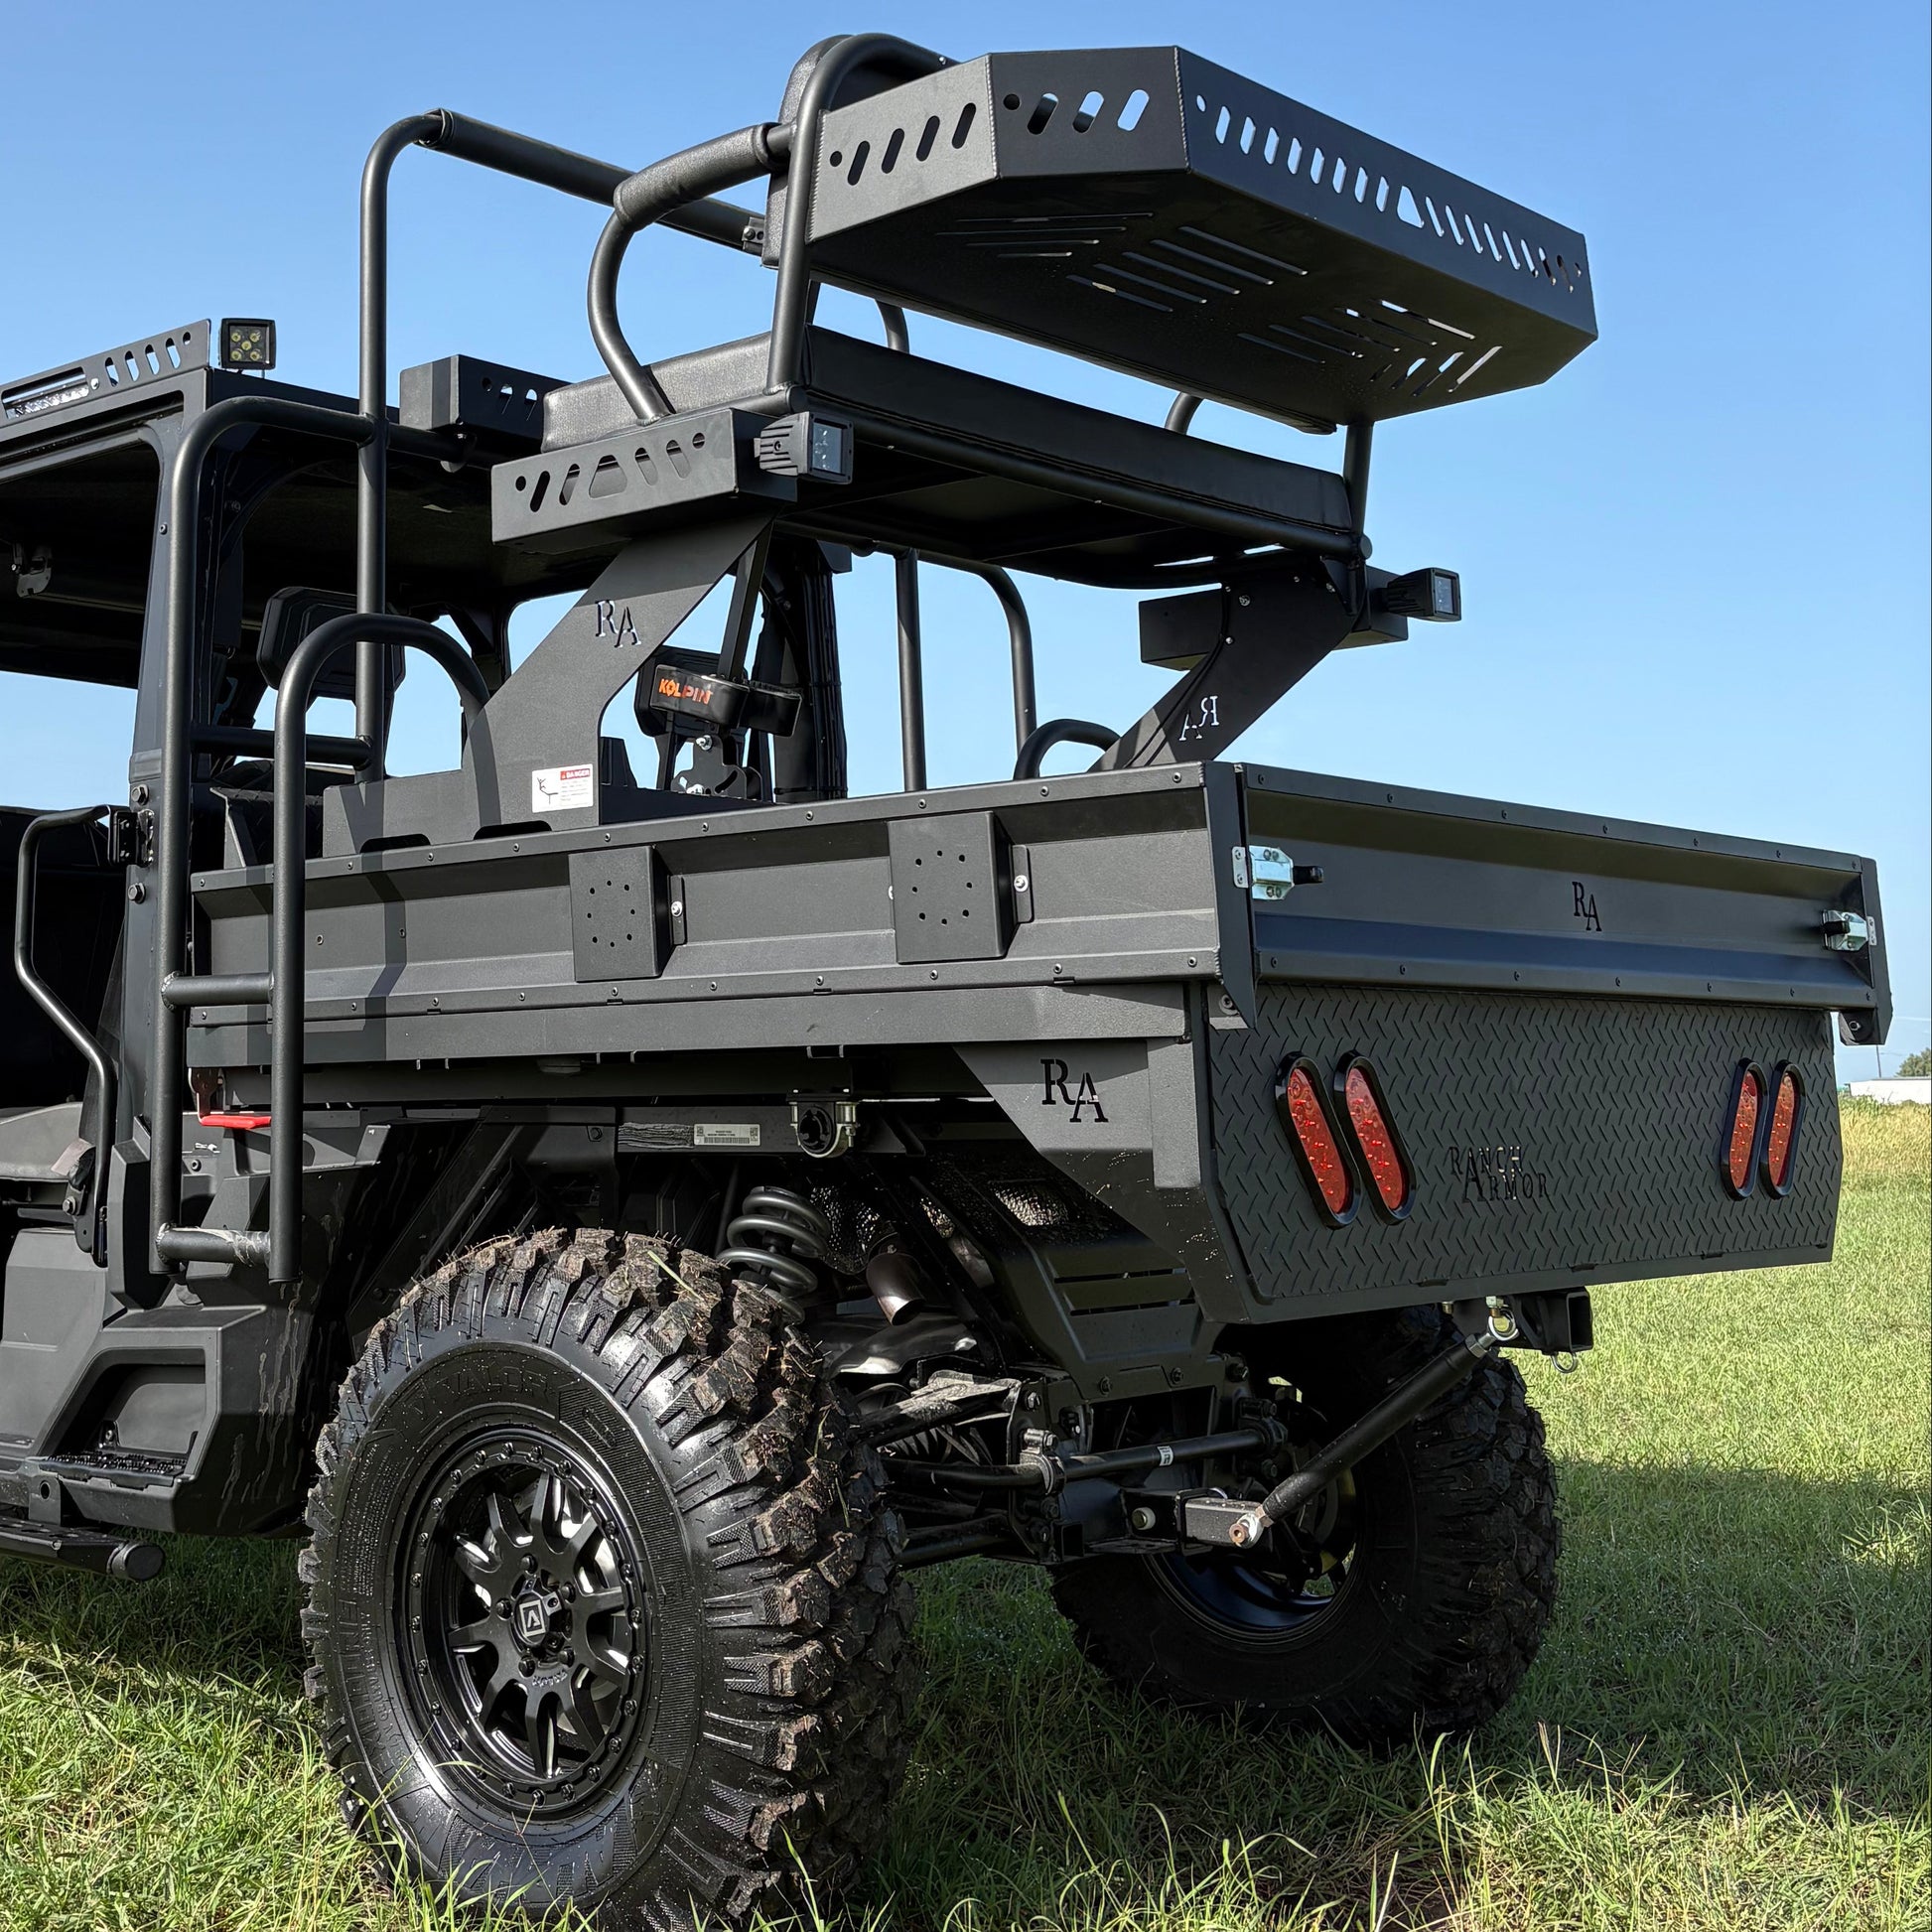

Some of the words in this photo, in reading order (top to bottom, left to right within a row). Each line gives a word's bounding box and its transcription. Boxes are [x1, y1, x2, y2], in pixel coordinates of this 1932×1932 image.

[595, 599, 641, 648] RA
[1571, 881, 1602, 932] RA
[1039, 1058, 1109, 1123] RA
